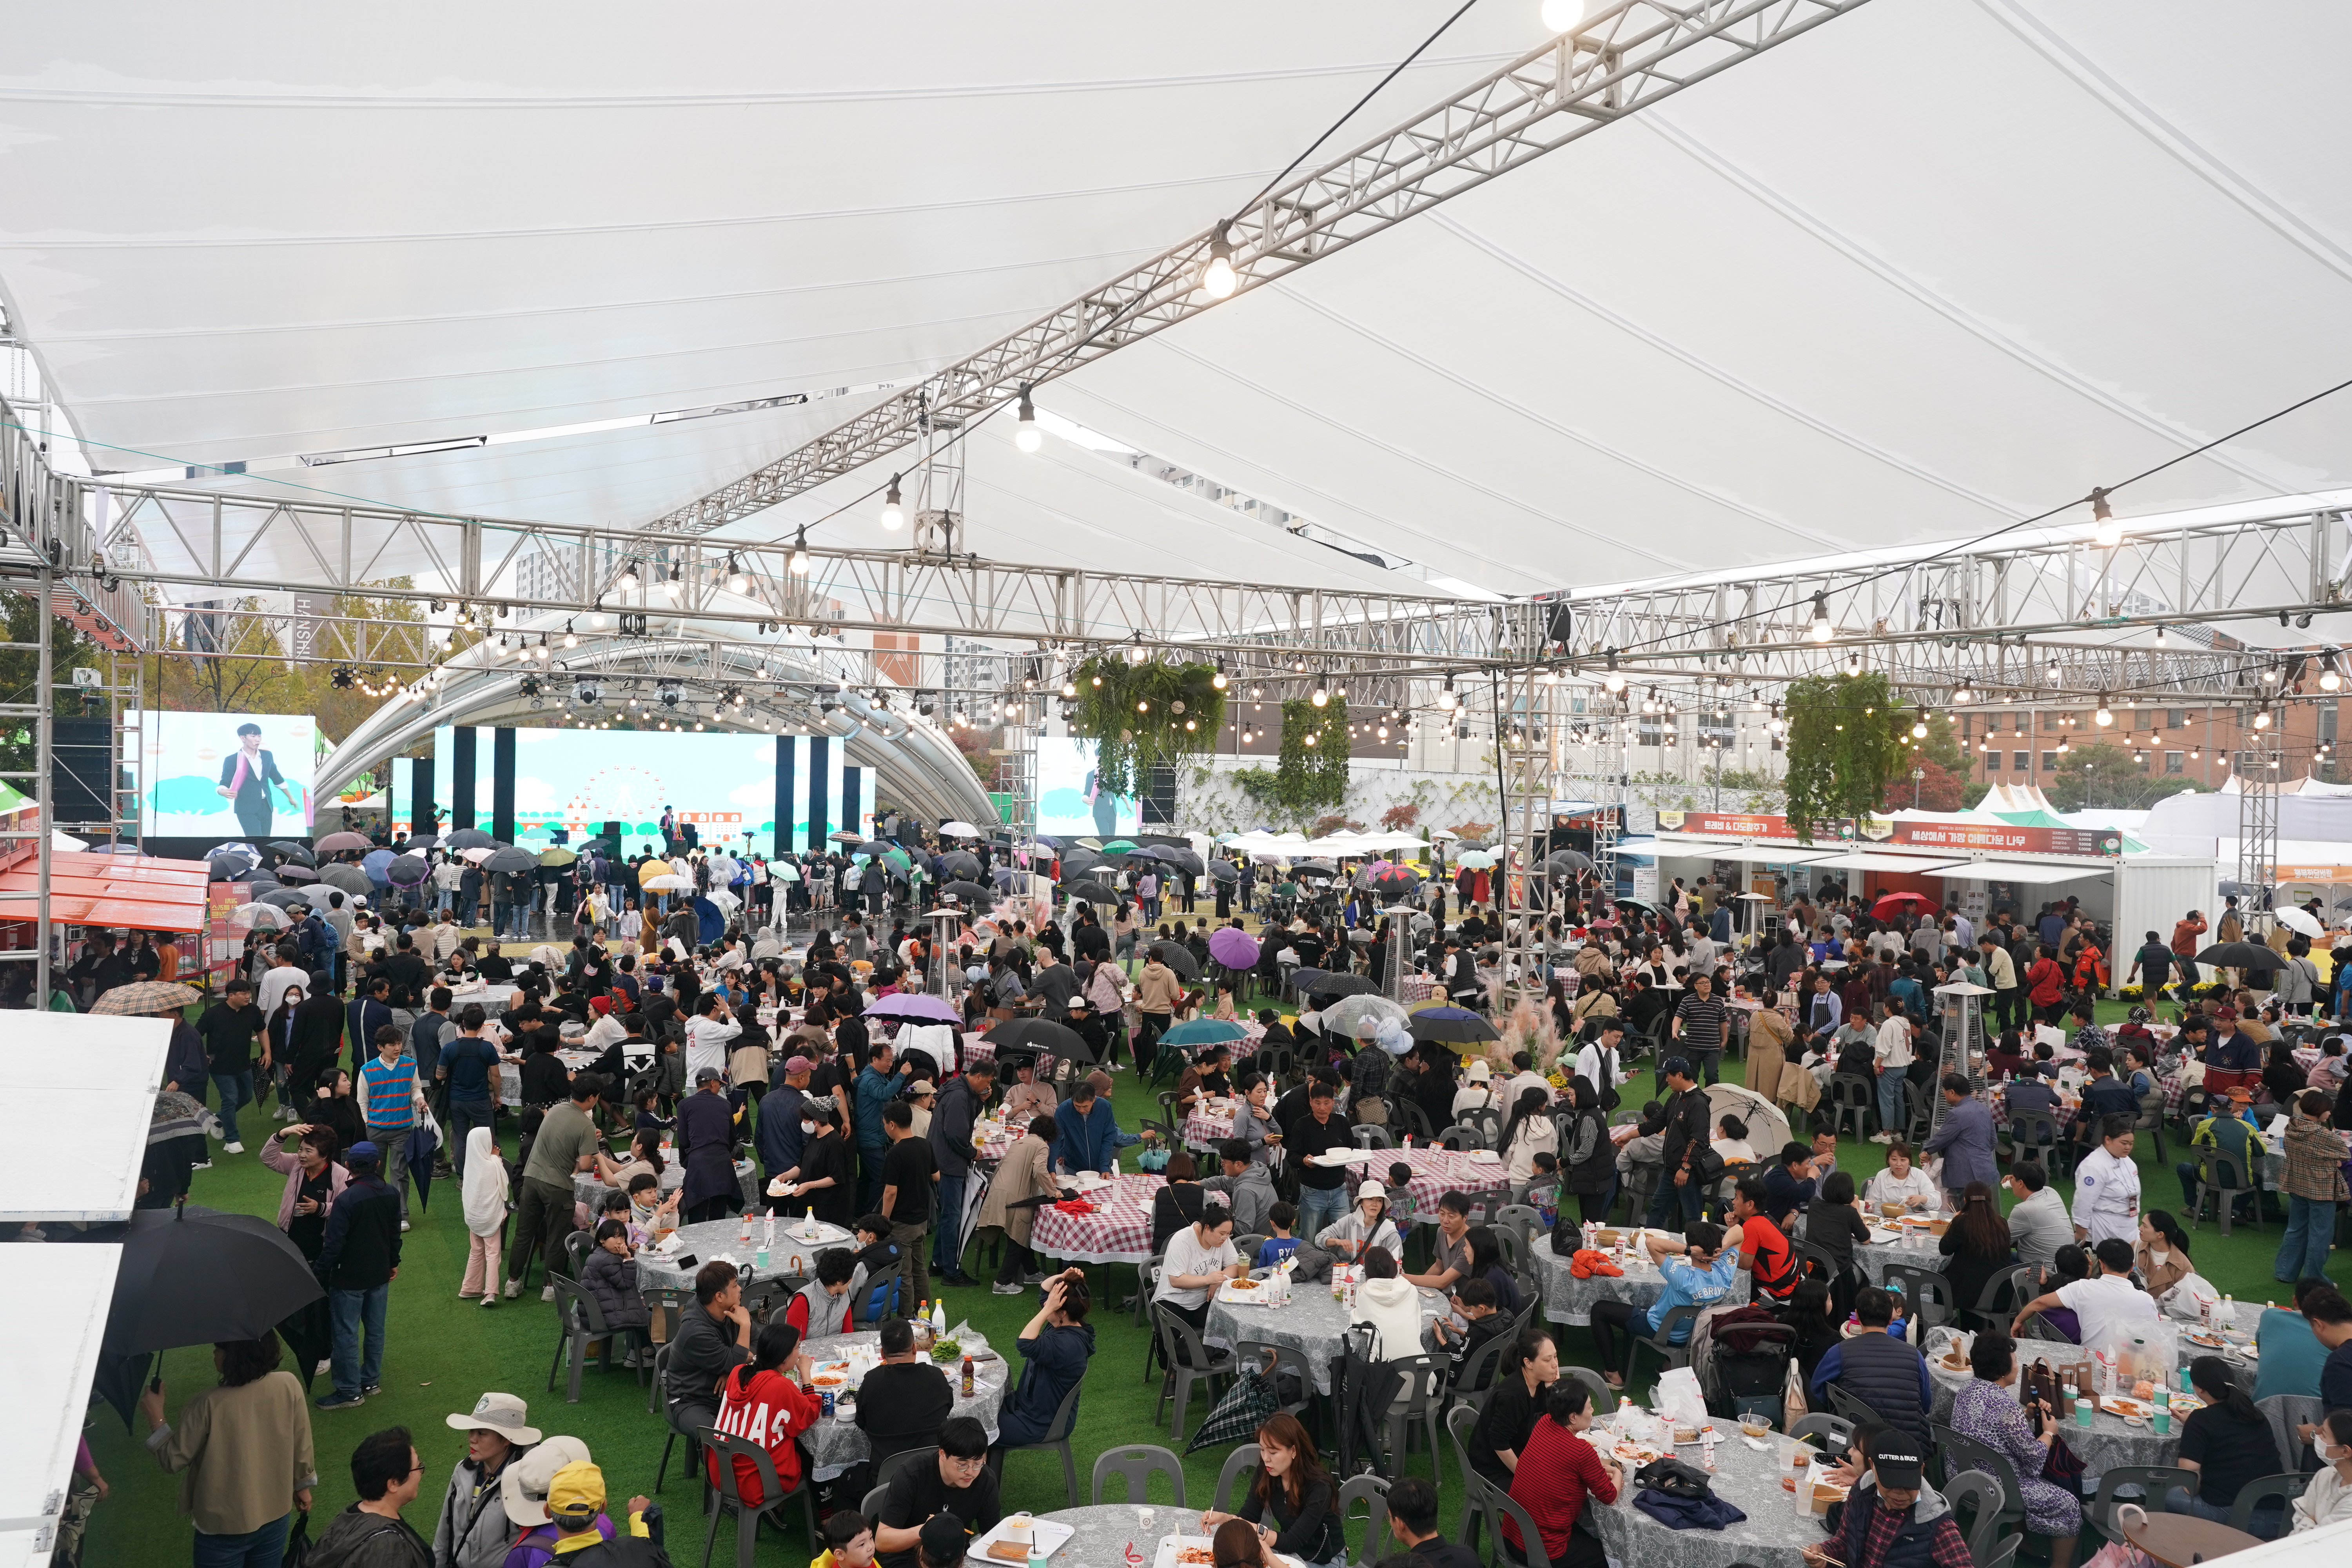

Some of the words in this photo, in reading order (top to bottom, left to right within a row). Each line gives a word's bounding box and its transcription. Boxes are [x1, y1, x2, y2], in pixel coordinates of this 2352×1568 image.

[1704, 820, 1724, 830] 트레비
[1726, 822, 1732, 831] &
[1733, 822, 1768, 832] 다도참주가
[1911, 830, 1946, 842] 세상에서
[1948, 832, 1965, 843] 가장
[1968, 833, 2004, 845] 아름다운
[2006, 835, 2025, 846] 나무
[1154, 1268, 1161, 1281] 9
[1692, 1290, 1703, 1300] DE
[820, 1494, 833, 1503] adidas
